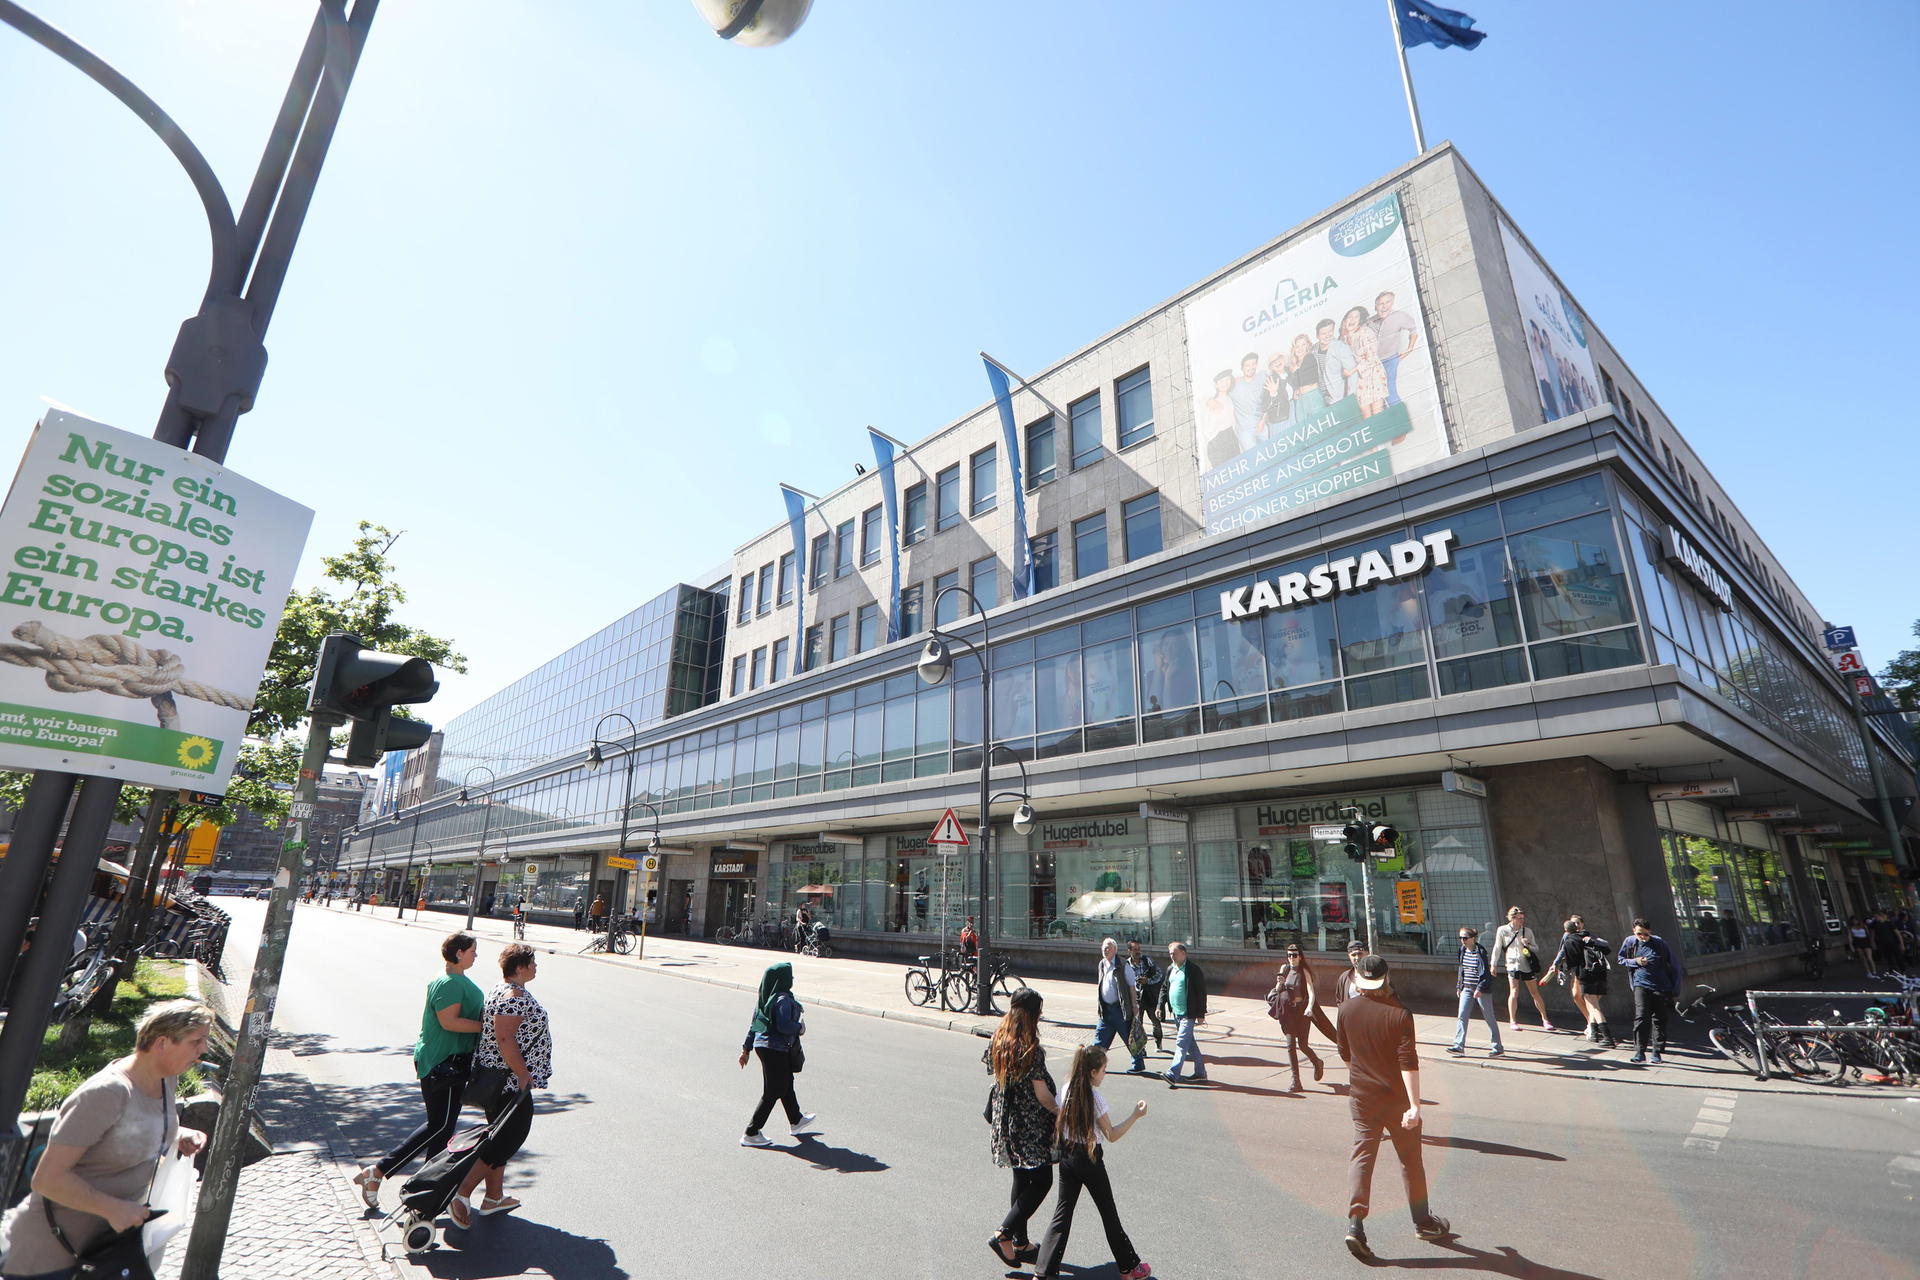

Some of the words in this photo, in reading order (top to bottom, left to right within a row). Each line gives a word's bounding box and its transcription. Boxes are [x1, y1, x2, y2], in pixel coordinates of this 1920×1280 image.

[1334, 205, 1394, 242] ZUSAMMEN
[1343, 212, 1396, 249] DEINS
[1242, 275, 1339, 333] GALERIA
[58, 432, 166, 488] Nur
[172, 469, 239, 519] ein
[1206, 453, 1250, 492] MEHR
[1255, 411, 1341, 465] AUSWAHL
[1209, 476, 1272, 513] BESSERE
[1276, 426, 1374, 483] ANGEBOTE
[42, 472, 235, 547] soziales
[1210, 495, 1290, 536] SCHÖNER
[1295, 459, 1381, 505] SHOPPEN
[28, 498, 210, 576] Europa
[218, 554, 268, 595] ist
[1220, 528, 1454, 622] KARSTADT
[1669, 524, 1735, 612] KARSTADT
[0, 570, 195, 645] Europa.
[13, 541, 101, 583] ein
[110, 562, 268, 631] starkes
[1833, 633, 1846, 644] P
[0, 712, 29, 726] mt,
[33, 716, 65, 729] wir
[66, 719, 119, 737] bauen
[0, 726, 33, 738] eue
[35, 727, 105, 748] Europa!
[1256, 796, 1388, 828] Hugendubel
[1683, 784, 1699, 792] dm
[791, 840, 837, 856] Hugendubel
[1043, 817, 1129, 843] Hugendubel
[713, 863, 744, 873] KARSTADT
